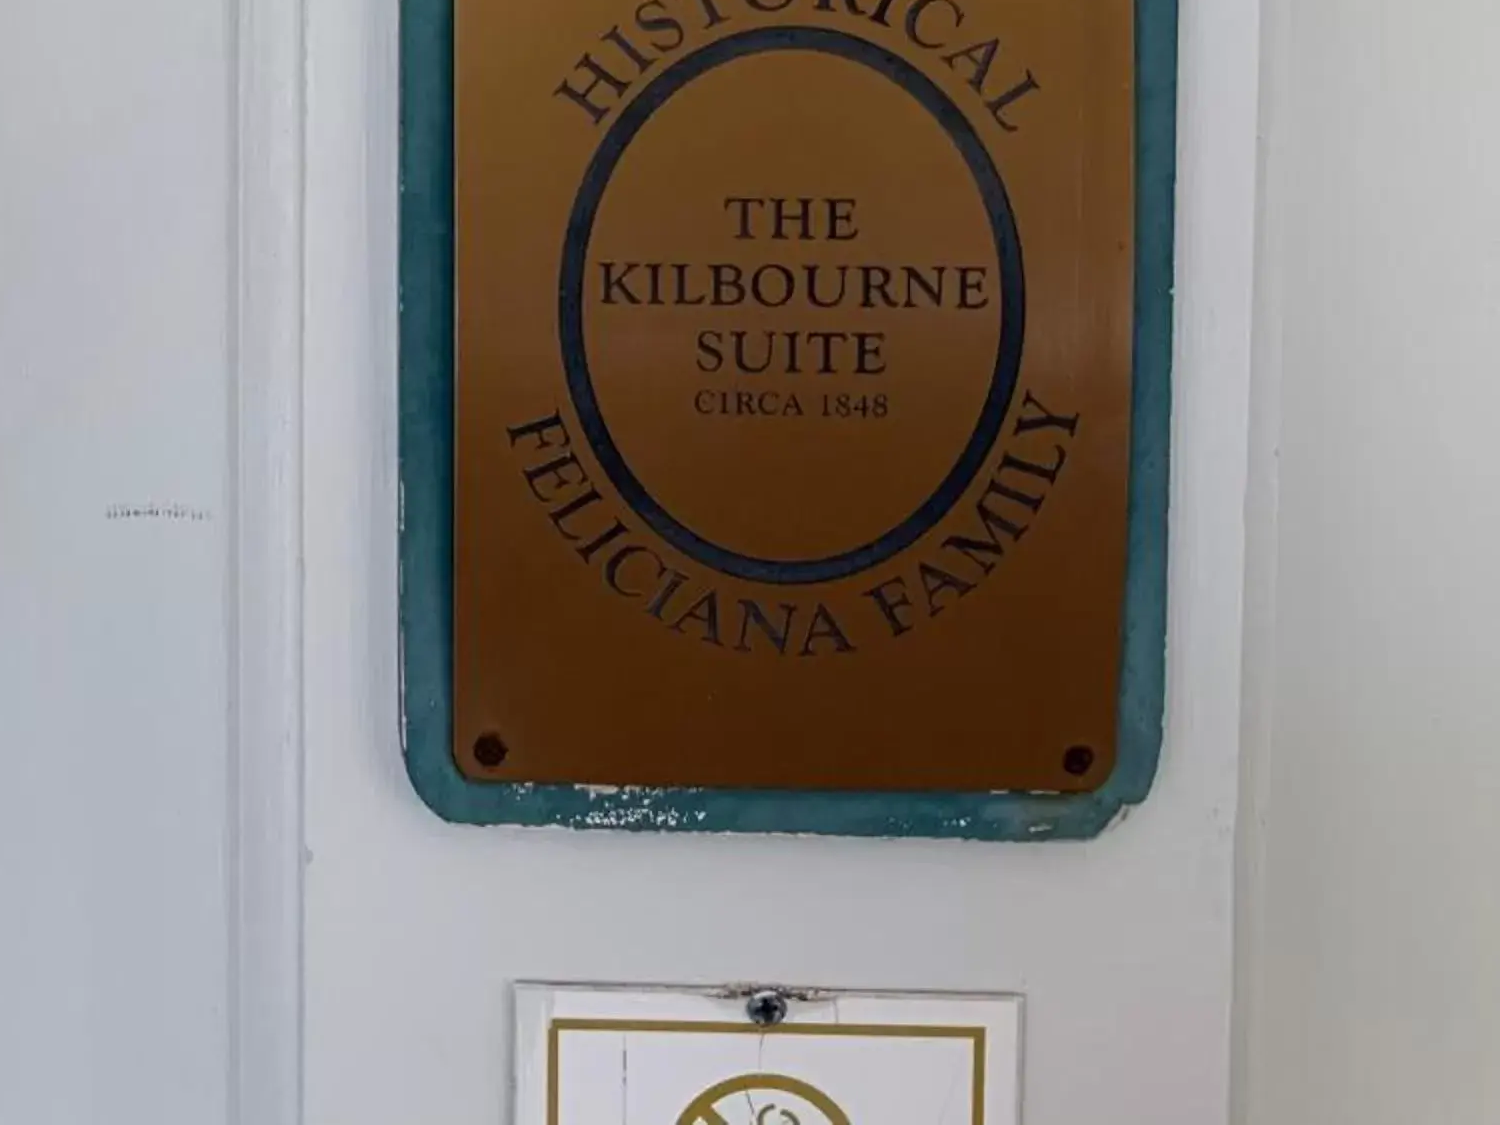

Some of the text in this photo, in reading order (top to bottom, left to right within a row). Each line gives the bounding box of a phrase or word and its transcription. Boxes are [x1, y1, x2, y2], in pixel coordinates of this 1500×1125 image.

[723, 195, 859, 243] THE
[597, 260, 991, 311] KILBOURNE
[694, 328, 888, 377] SUITE
[693, 386, 890, 419] CIRCA 1848
[506, 386, 1081, 659] FELICIANA FAMILY
